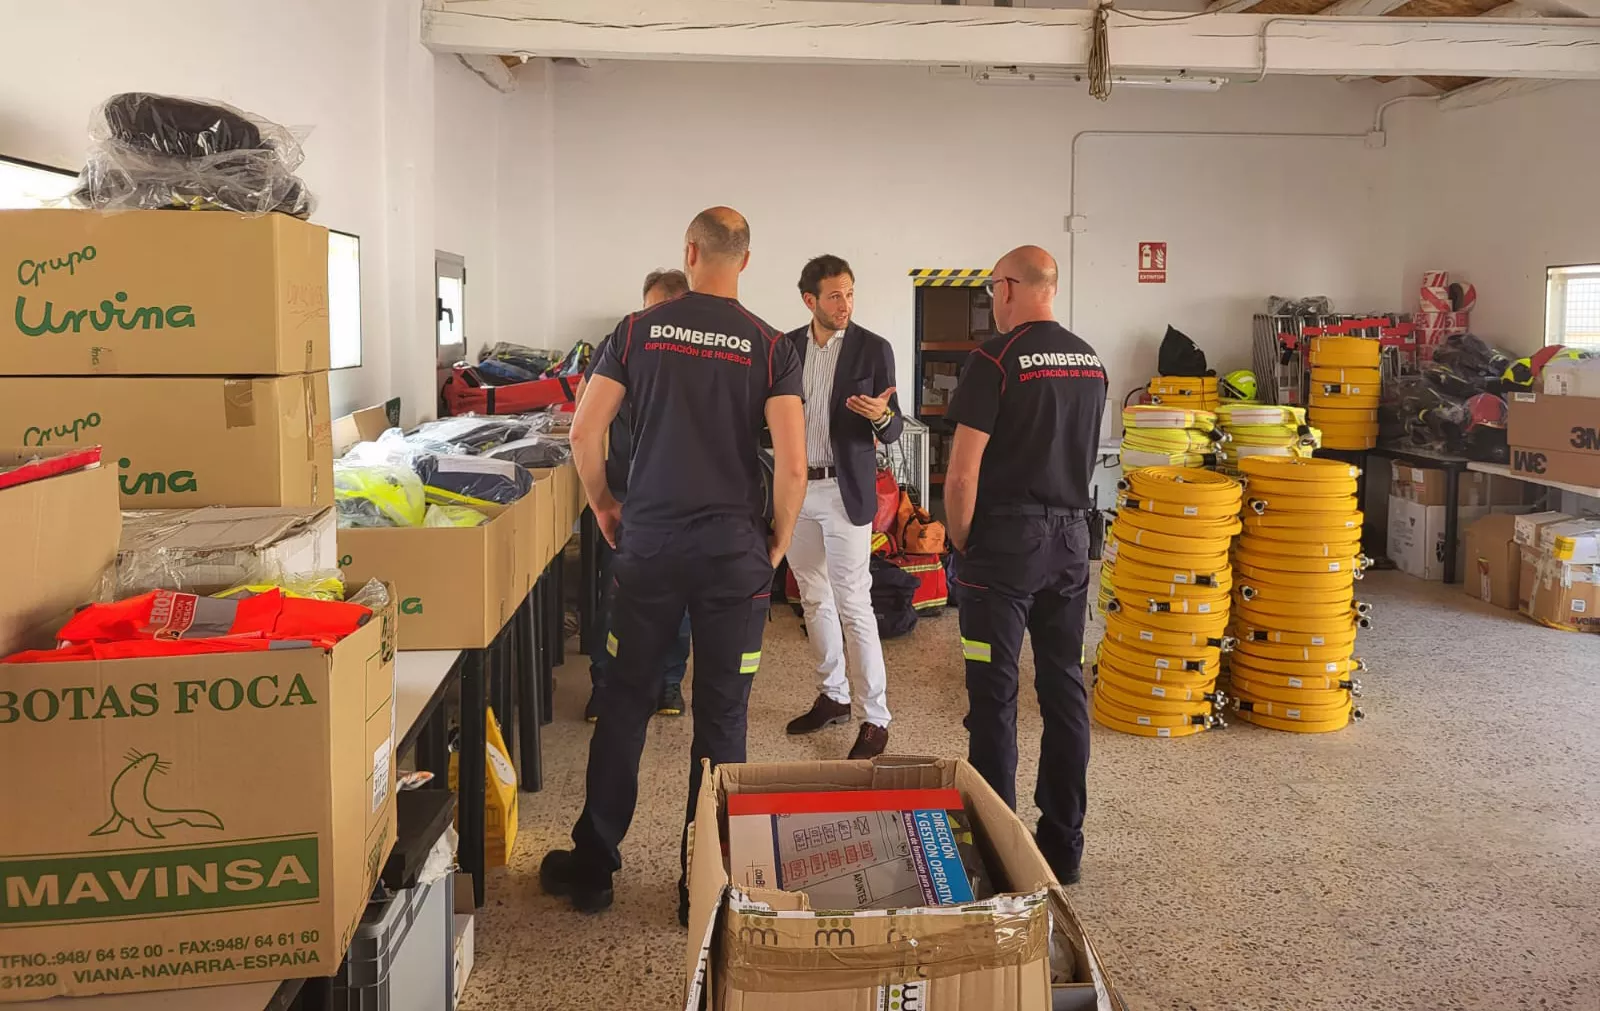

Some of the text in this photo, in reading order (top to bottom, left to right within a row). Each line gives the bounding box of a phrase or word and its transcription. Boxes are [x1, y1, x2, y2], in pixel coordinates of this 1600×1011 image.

[17, 245, 97, 287] Grupo
[15, 291, 196, 337] Urvina
[644, 342, 752, 366] DIPUTACIÓN DE HUESCA
[650, 325, 752, 353] BOMBEROS
[1018, 352, 1101, 369] BOMBEROS
[1070, 369, 1080, 378] DE
[150, 590, 172, 623] EROS
[0, 673, 317, 724] BOTAS FOCA
[931, 812, 956, 859] DIRECCIÓN
[5, 854, 312, 909] MAVINSA
[918, 820, 940, 858] GESTIÓN
[930, 860, 955, 905] OPERATIV
[96, 948, 115, 962] 64
[120, 946, 140, 960] 52
[143, 944, 163, 958] 00
[254, 934, 273, 948] 64
[278, 932, 295, 946] 61
[301, 930, 319, 944] 60
[1, 947, 320, 989] 31230 VIANA-NAVARRA-ESPAÑA
